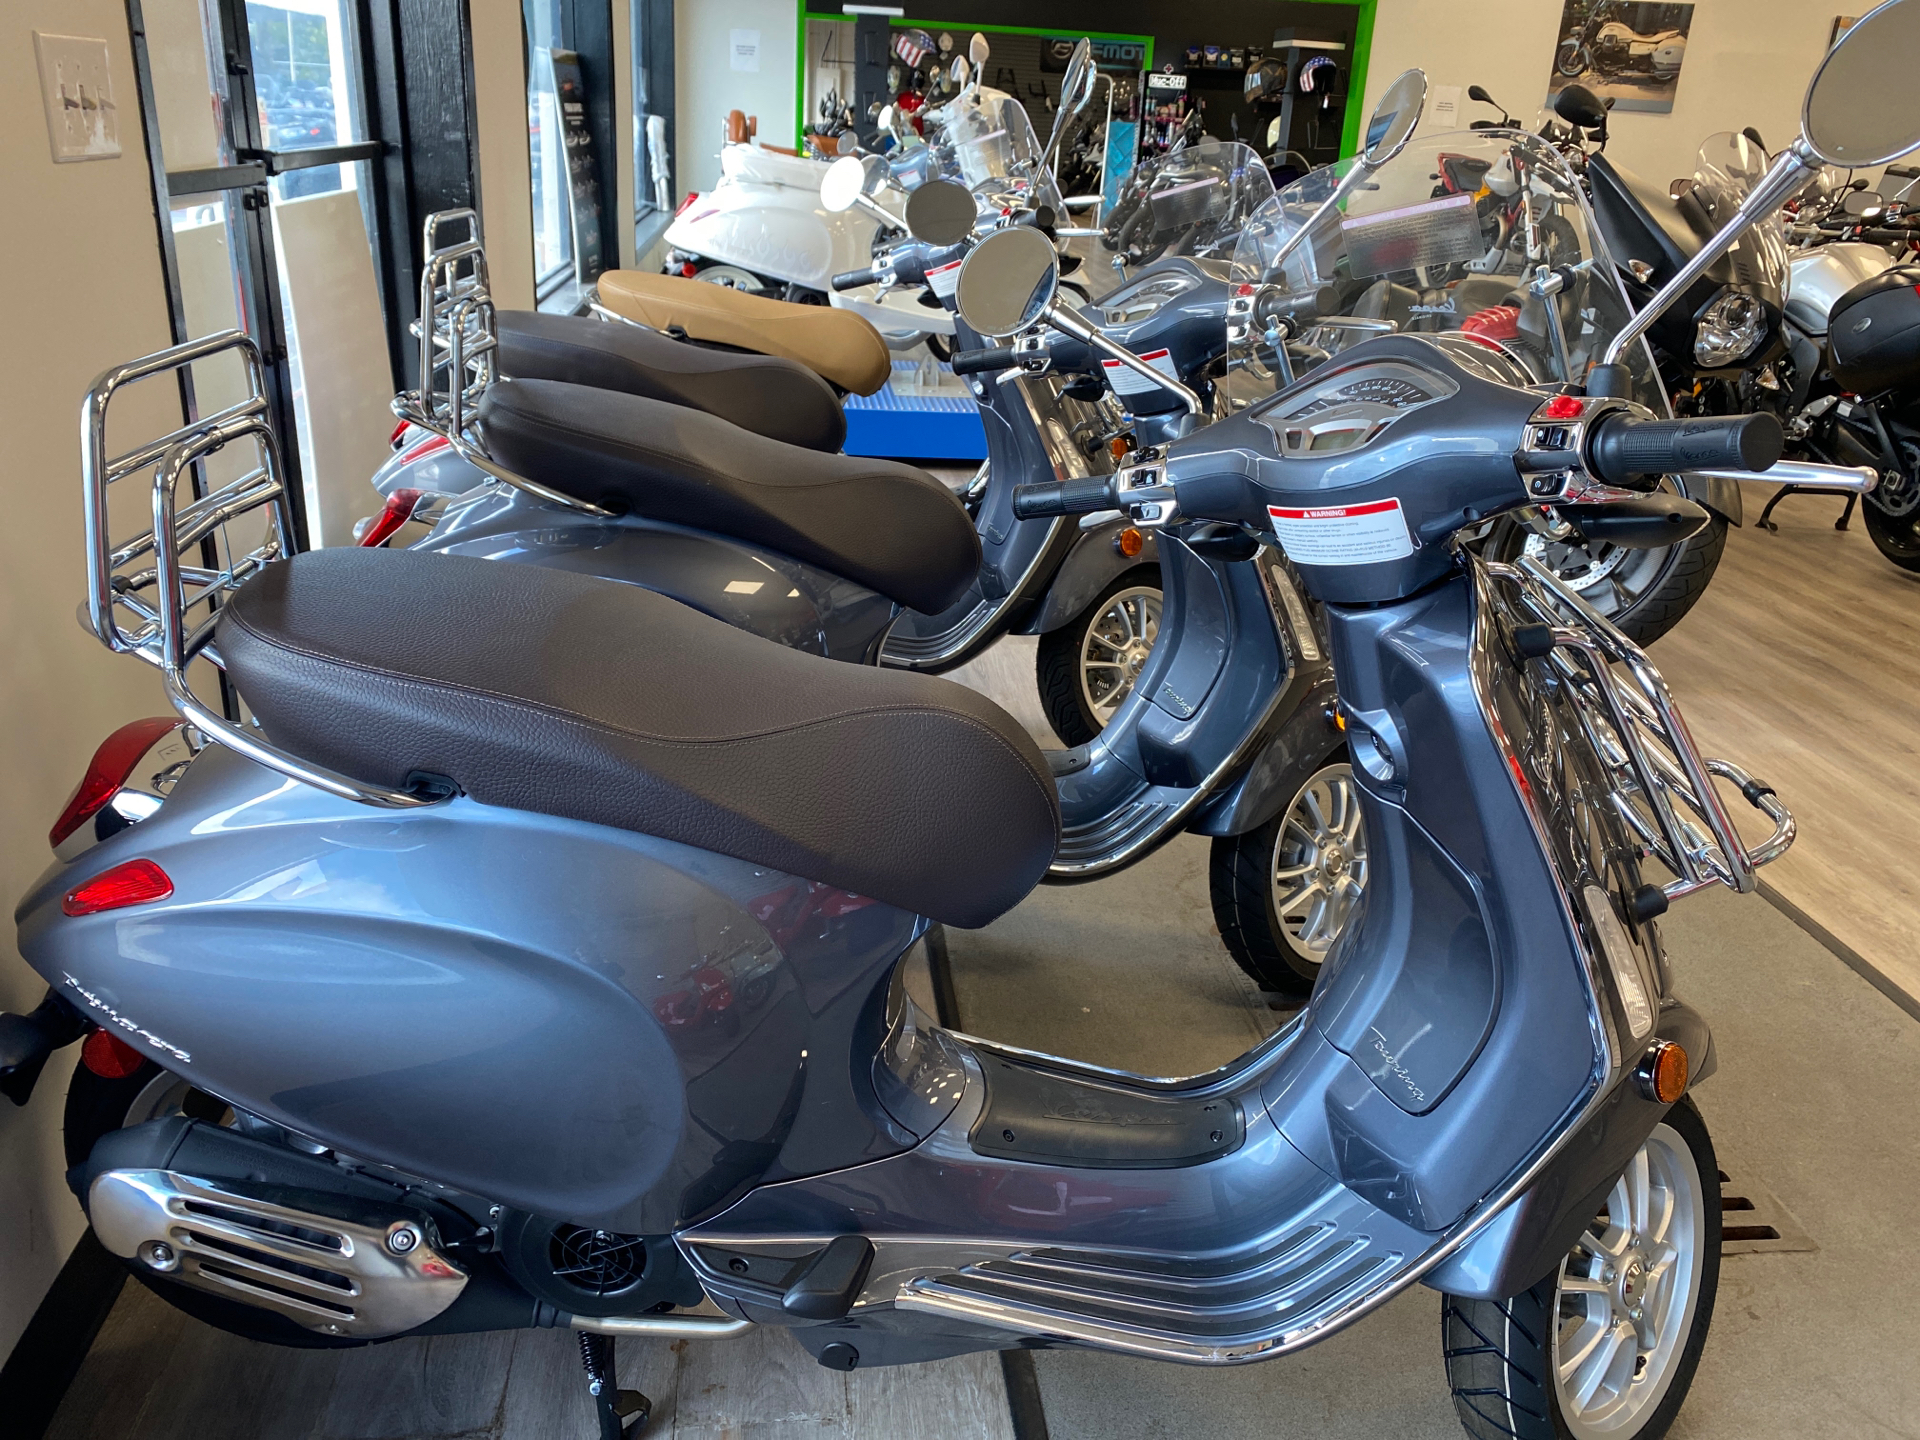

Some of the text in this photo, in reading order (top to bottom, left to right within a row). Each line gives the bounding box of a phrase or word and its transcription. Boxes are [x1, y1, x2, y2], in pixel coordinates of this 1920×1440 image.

[1091, 44, 1145, 61] FMOT
[1150, 75, 1186, 87] Muc-Off
[1310, 509, 1347, 518] WARNING!
[1370, 1026, 1425, 1102] Touring
